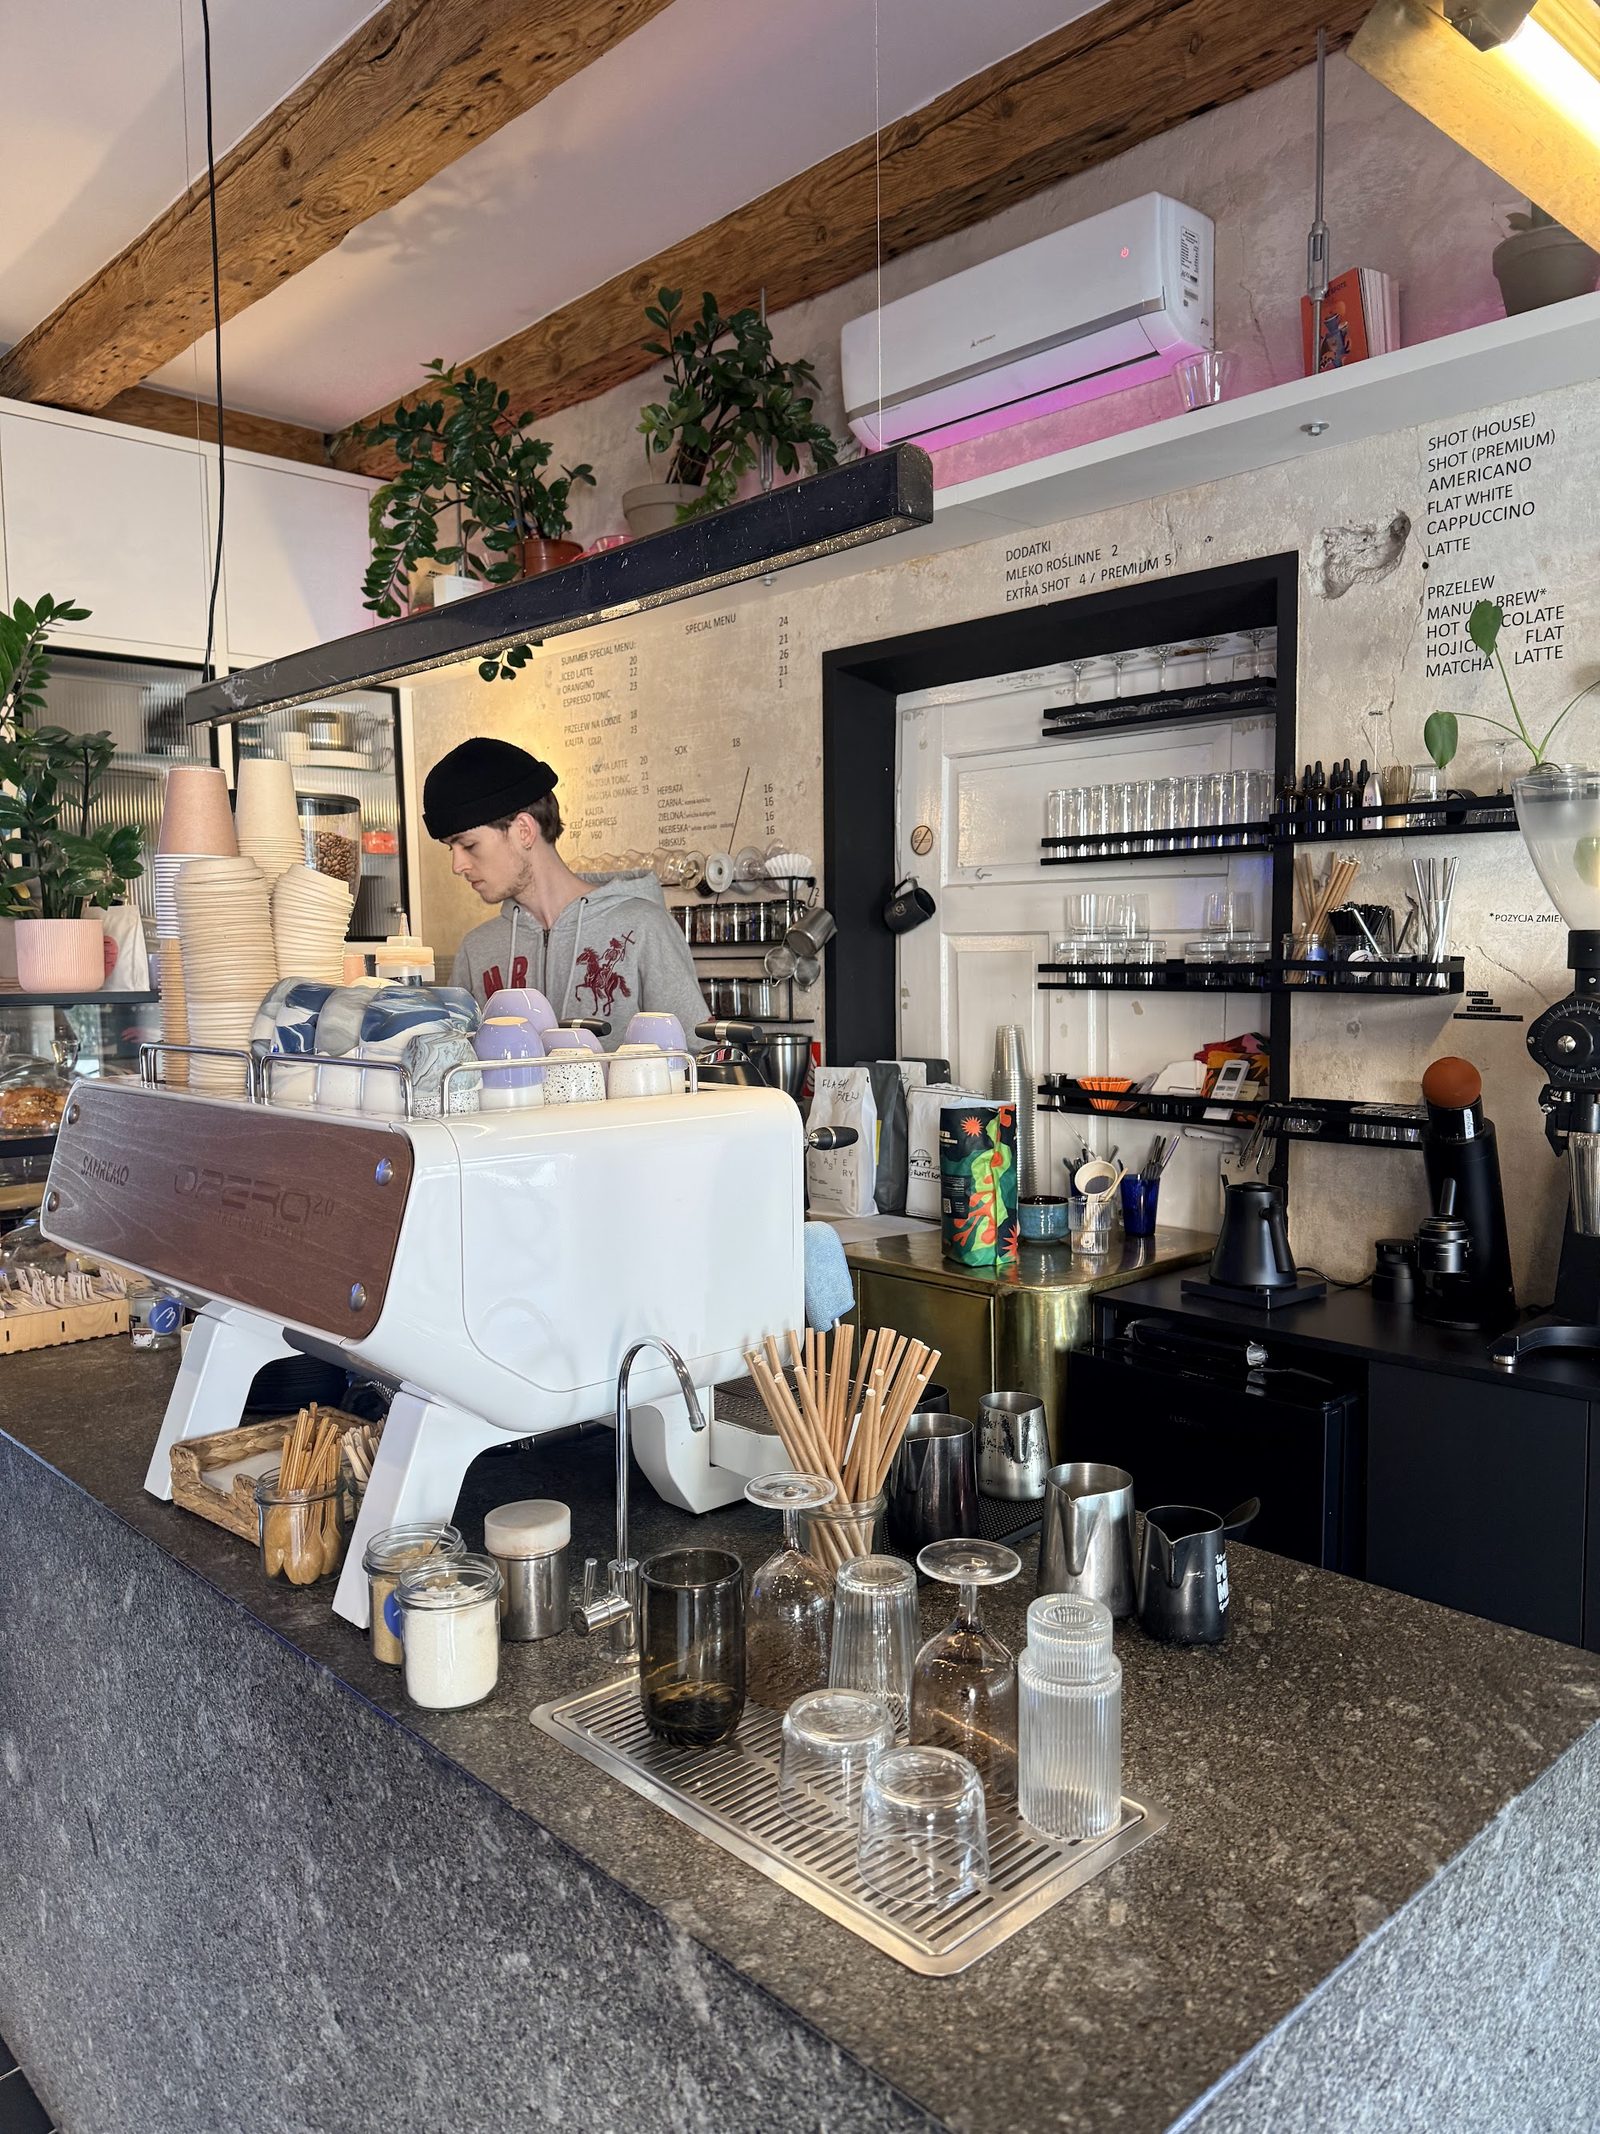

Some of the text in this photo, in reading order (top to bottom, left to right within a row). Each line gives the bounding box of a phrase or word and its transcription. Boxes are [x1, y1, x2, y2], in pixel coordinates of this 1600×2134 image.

[1428, 411, 1536, 451] SHOT (HOUSE)
[1428, 429, 1556, 472] SHOT (PREMIUM)
[1428, 457, 1532, 493] AMERICANO
[1427, 484, 1513, 515] FLAT WHITE
[1427, 501, 1535, 535] CAPPUCCINO
[1006, 541, 1051, 562] DODATKI
[1427, 537, 1471, 557] LATTE
[1006, 544, 1119, 582] MLEKO ROŚLINNE 2
[1006, 585, 1039, 602] EXTRA
[1041, 577, 1070, 594] SHOT
[1079, 573, 1086, 586] 4
[1101, 557, 1159, 581] PREMIUM
[1164, 553, 1172, 567] 5
[1428, 575, 1495, 599] PRZELEW
[1427, 600, 1480, 620] MANU
[685, 613, 737, 635] SPECIAL MENU
[779, 616, 789, 627] 24
[1427, 605, 1565, 639] HOT CCOLATE
[779, 633, 788, 645] 21
[1427, 625, 1565, 658] HOJIC FLAT
[561, 651, 588, 666] SUMMER
[589, 647, 614, 660] SPECIAL
[780, 649, 789, 660] 26
[1426, 645, 1564, 678] MATCHA LATTE
[576, 667, 594, 678] LATTE
[779, 665, 788, 676] 21
[563, 694, 592, 708] ESPRESSO
[674, 737, 741, 756] SOK 18
[764, 783, 773, 793] 16
[764, 796, 774, 807] 16
[765, 810, 775, 821] 16
[766, 825, 775, 835] 16
[81, 1155, 130, 1187] SANREMO
